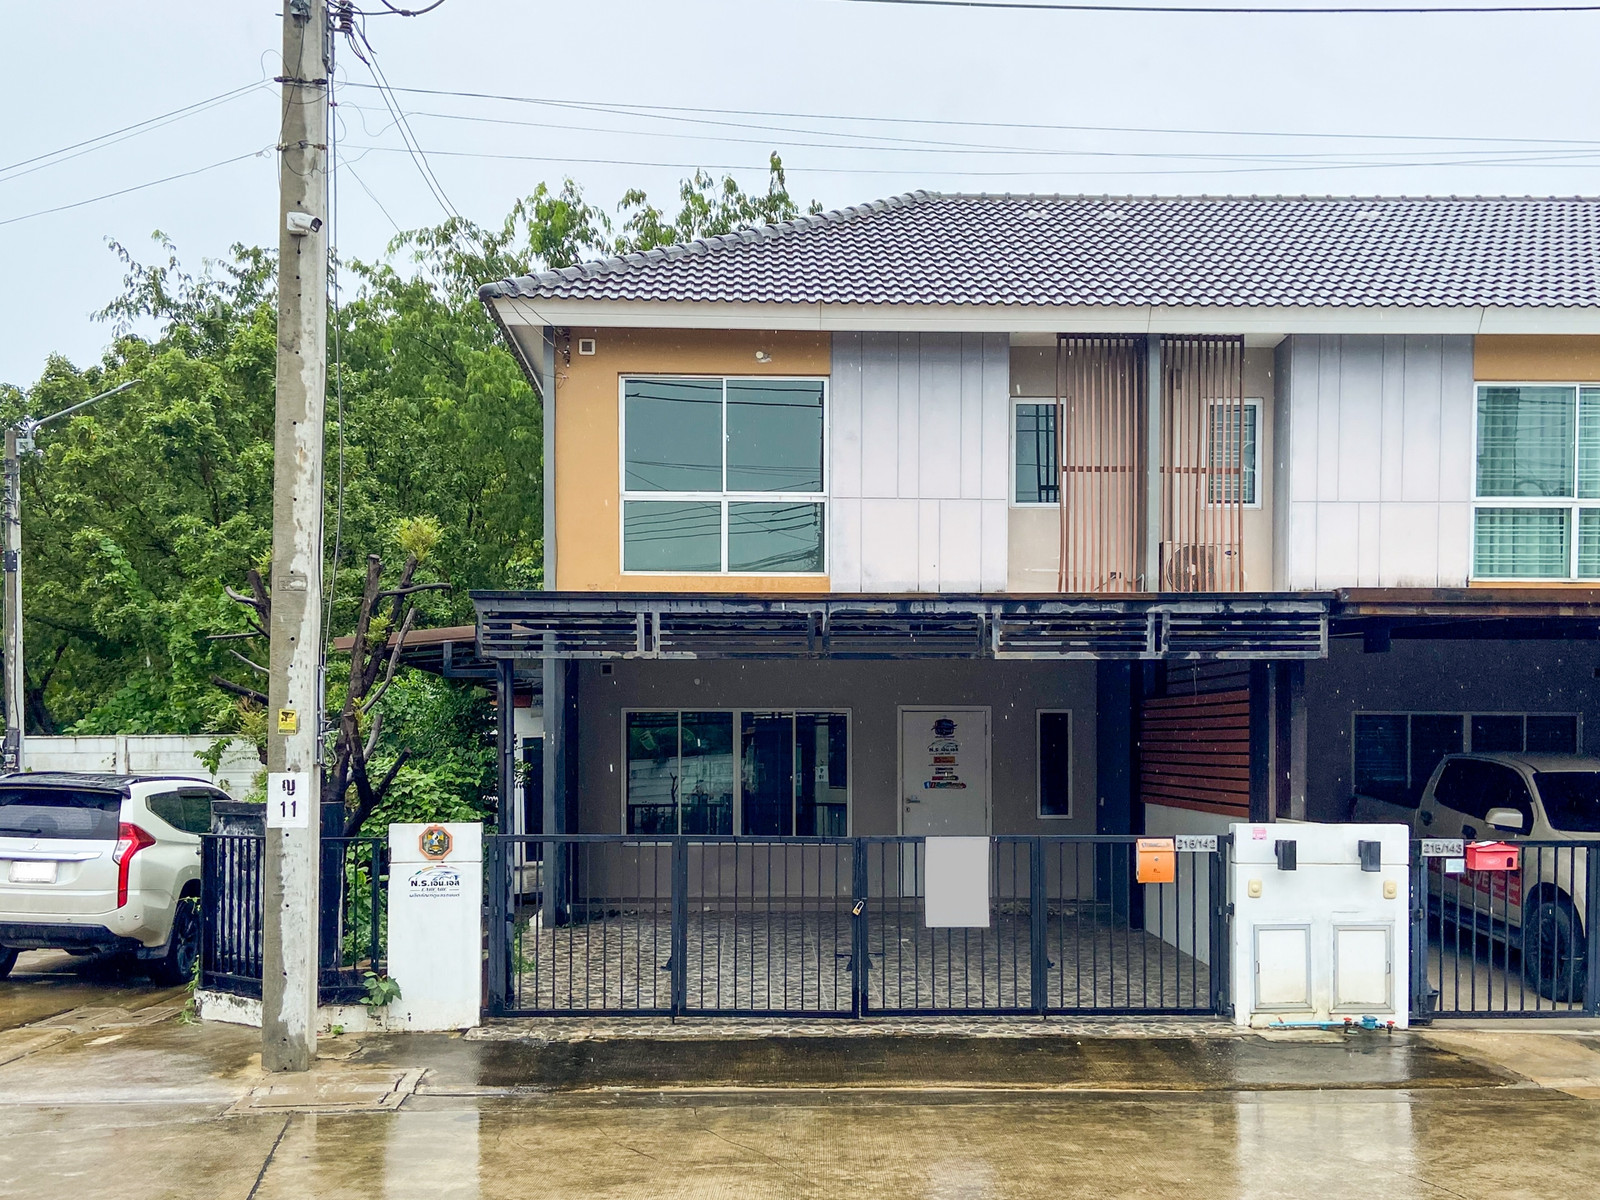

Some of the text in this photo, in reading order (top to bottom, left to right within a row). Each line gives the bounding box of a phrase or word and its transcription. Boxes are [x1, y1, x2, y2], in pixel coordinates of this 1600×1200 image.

[282, 779, 296, 796] ญ
[280, 800, 297, 818] 11
[1423, 843, 1462, 854] 215/143
